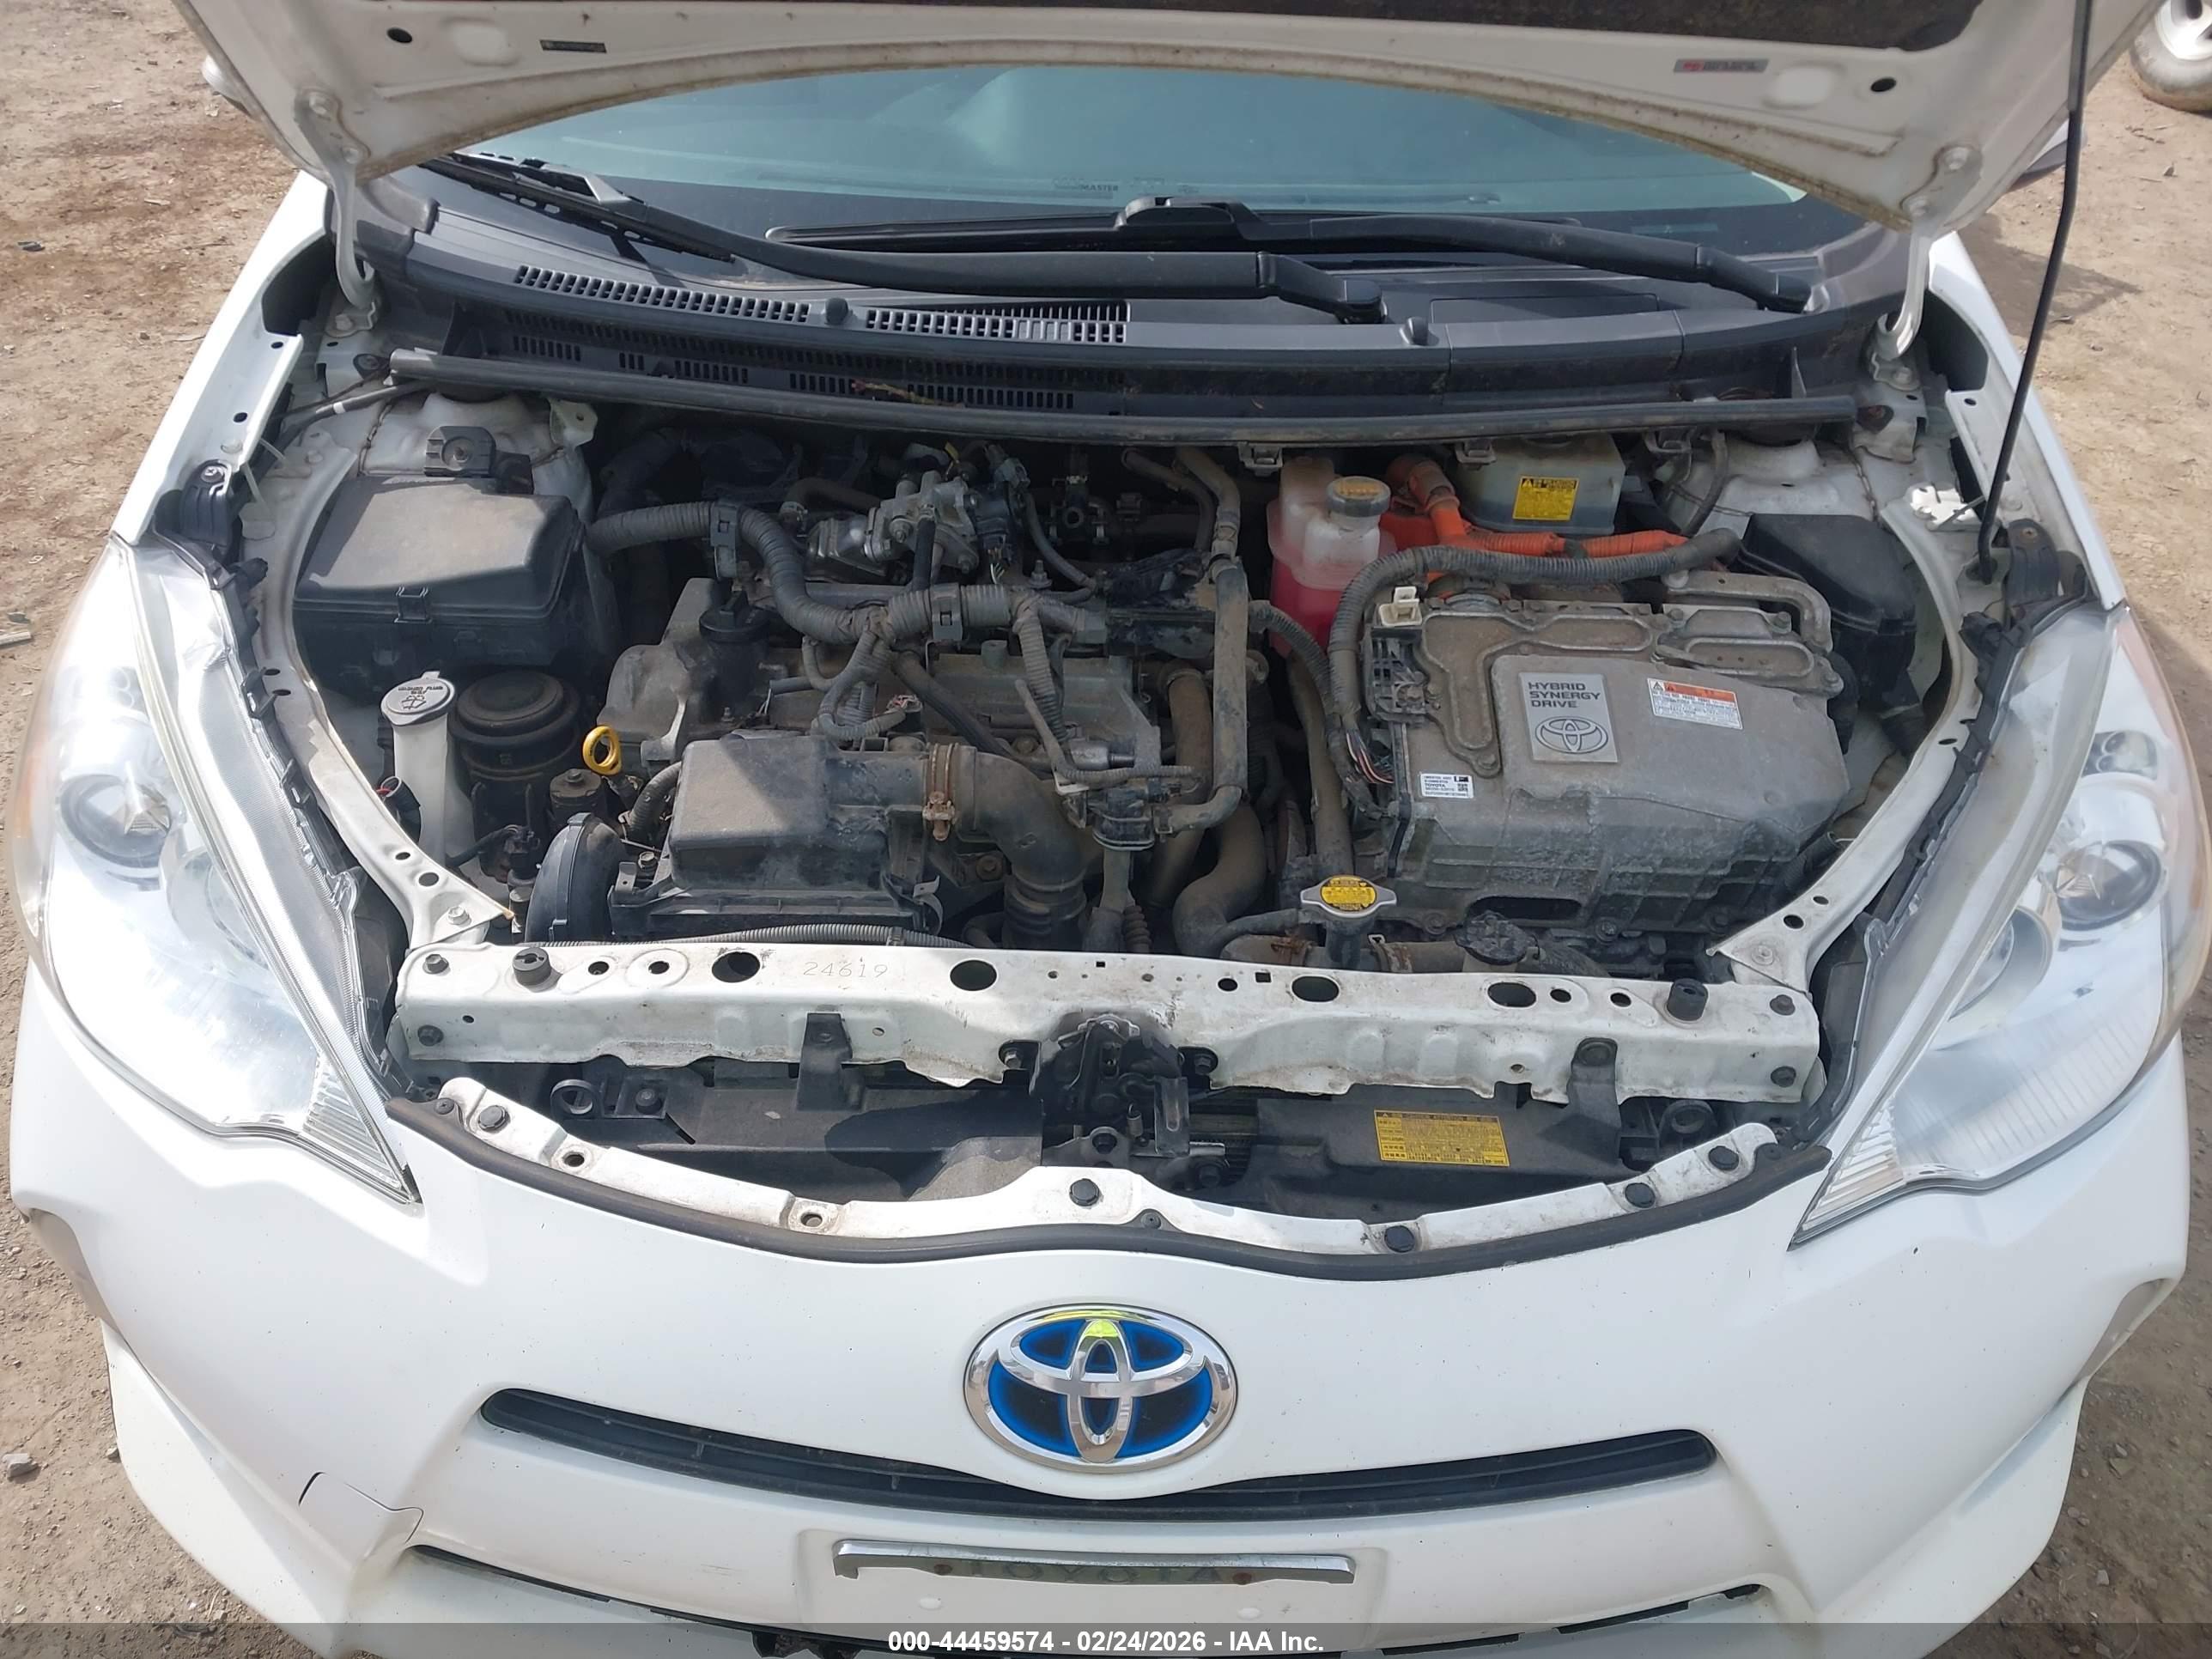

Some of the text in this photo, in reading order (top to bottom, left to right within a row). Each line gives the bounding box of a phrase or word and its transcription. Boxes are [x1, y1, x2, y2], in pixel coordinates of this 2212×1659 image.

[1528, 682, 1586, 690] HYBRID
[1529, 690, 1601, 700] SYNERGY
[803, 961, 888, 978] 24619
